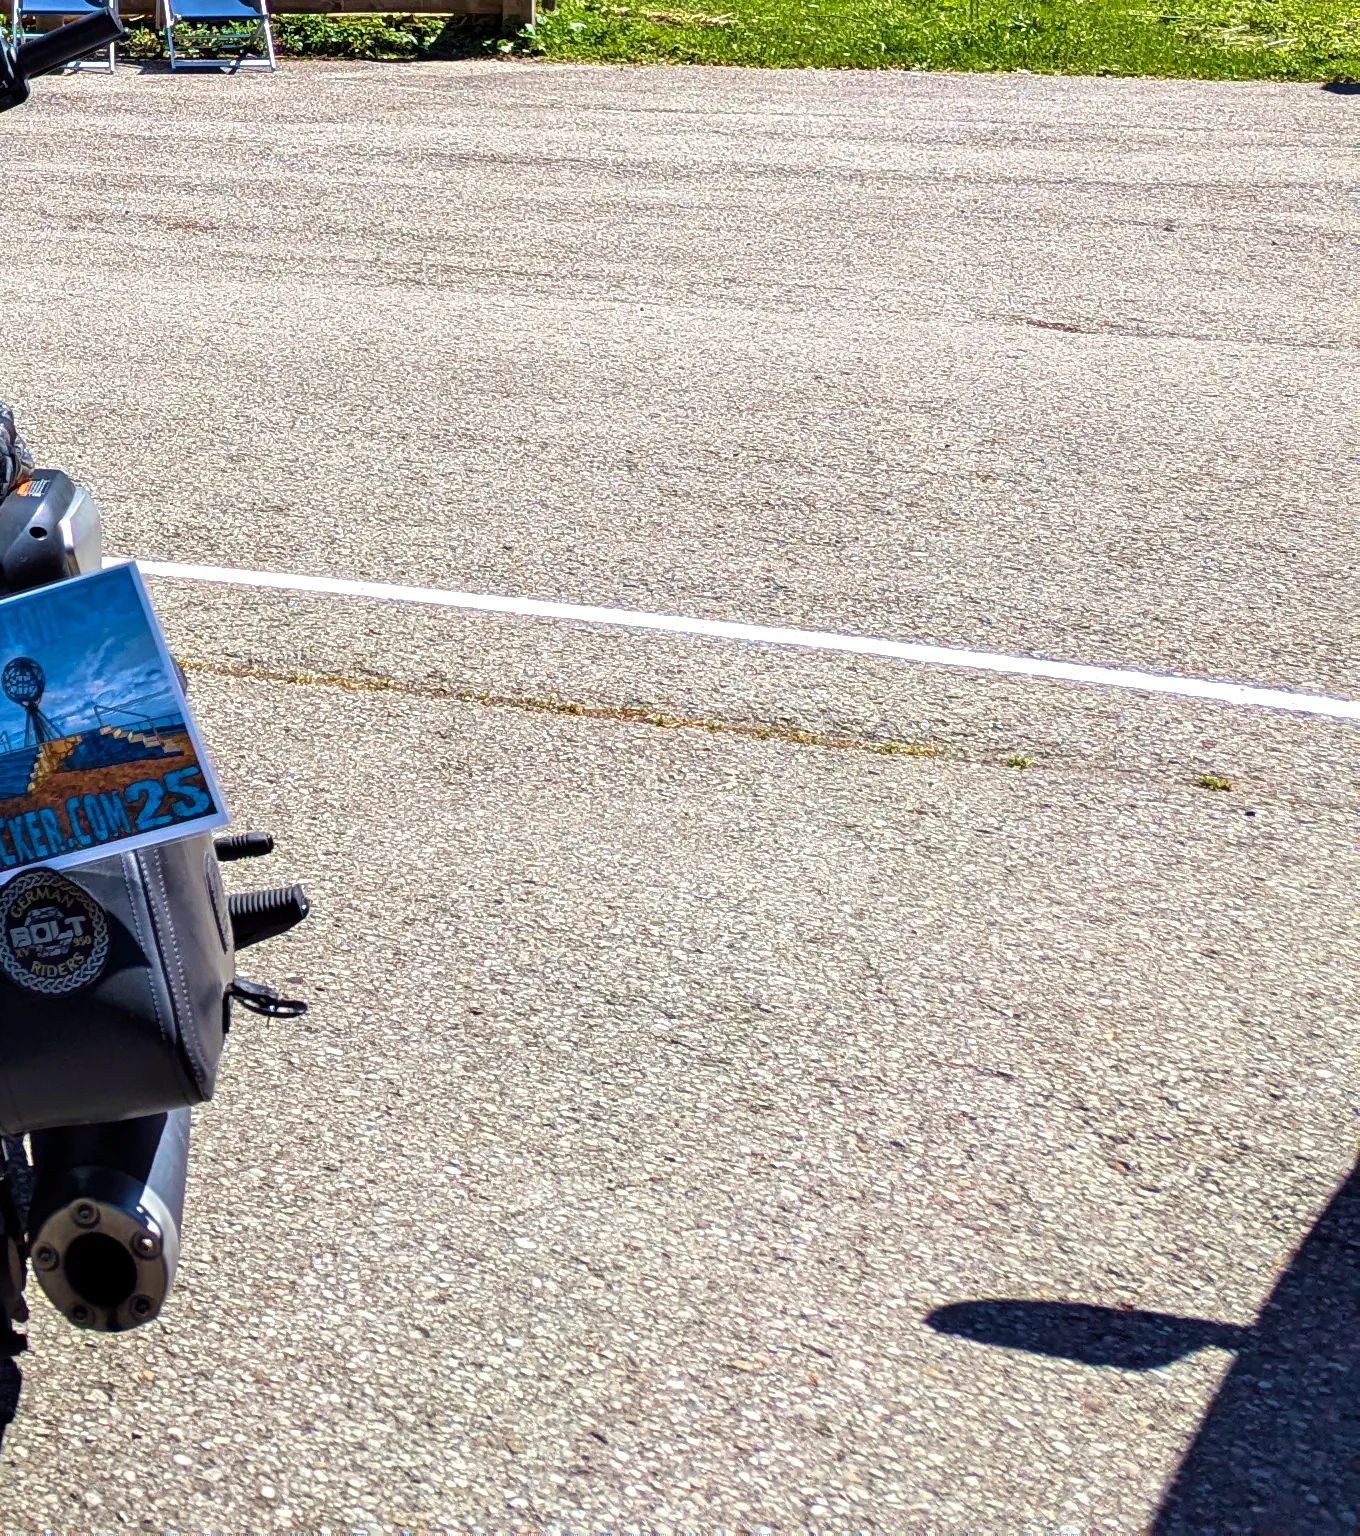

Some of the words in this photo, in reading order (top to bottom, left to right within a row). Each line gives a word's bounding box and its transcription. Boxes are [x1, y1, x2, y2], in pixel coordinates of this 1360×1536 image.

[124, 765, 211, 831] 25
[10, 886, 75, 918] GERMAN
[10, 916, 86, 948] BOLT
[31, 952, 85, 977] RIDERS
